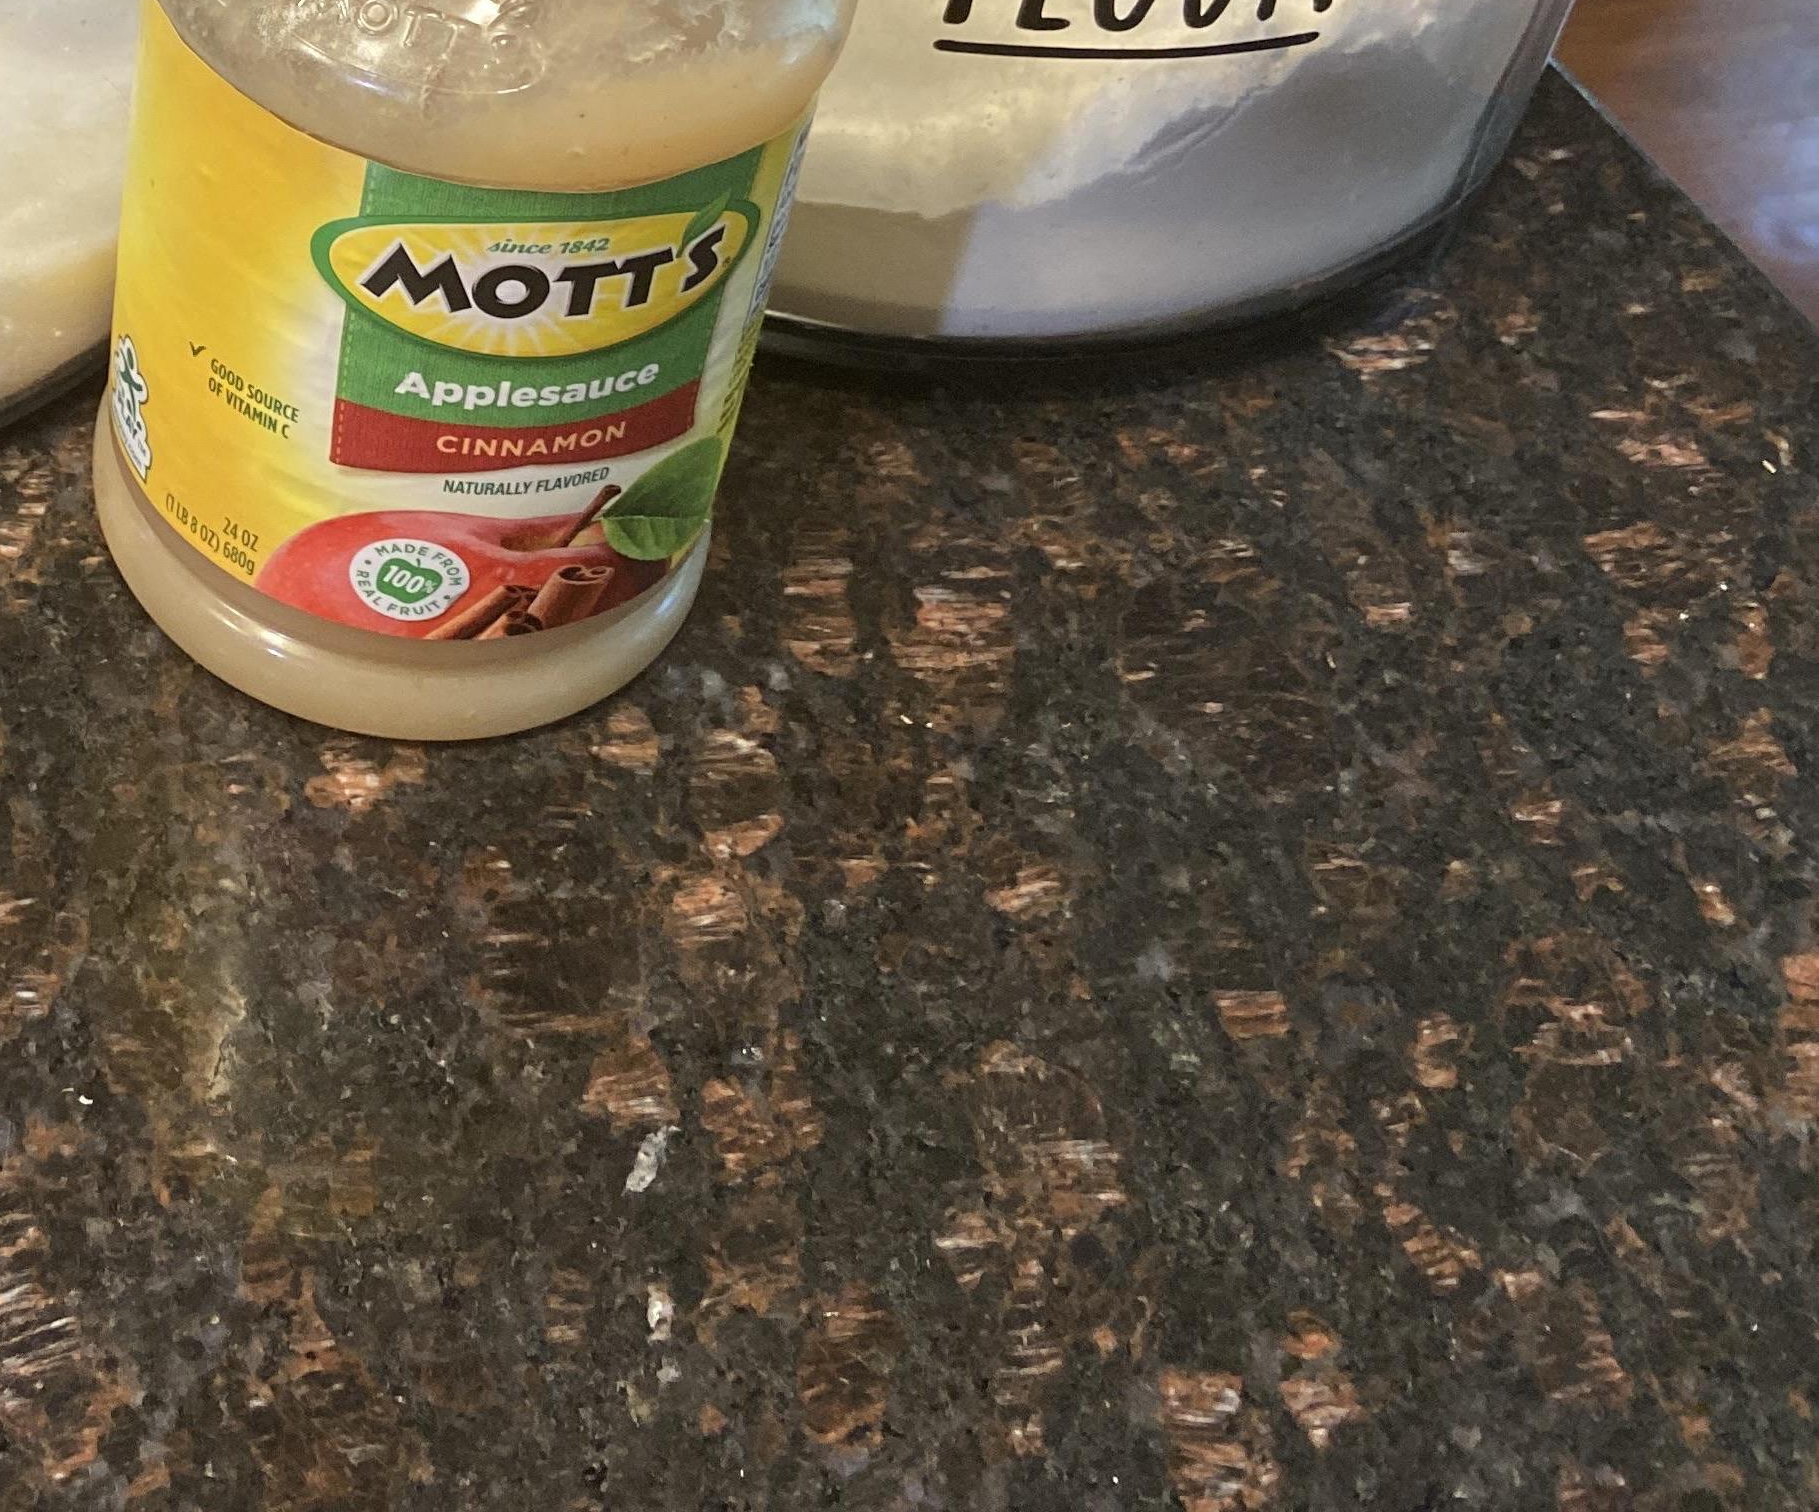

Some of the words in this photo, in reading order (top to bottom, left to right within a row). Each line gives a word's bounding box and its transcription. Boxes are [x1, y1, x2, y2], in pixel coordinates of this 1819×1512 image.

[488, 238, 552, 254] since
[560, 238, 610, 254] 1842
[360, 224, 727, 319] MOTT'S
[210, 358, 244, 392] GOOD
[247, 386, 301, 423] SOURCE
[395, 361, 660, 409] Applesauce
[208, 377, 223, 397] OF
[226, 388, 277, 434] VITAMIN
[281, 424, 291, 439] C
[436, 421, 626, 457] CINNAMON
[443, 479, 532, 496] NATURALLY
[535, 467, 610, 493] FLAVORED
[176, 502, 188, 525] LB
[190, 516, 198, 533] 8
[200, 524, 220, 553] OZ)
[223, 541, 255, 576] 680g
[223, 517, 238, 540] 24
[242, 530, 259, 553] OZ
[374, 543, 429, 556] MADE
[431, 552, 462, 586] FROM
[383, 565, 438, 594] 100%
[356, 568, 383, 606] REAL
[386, 600, 441, 616] FRUIT
